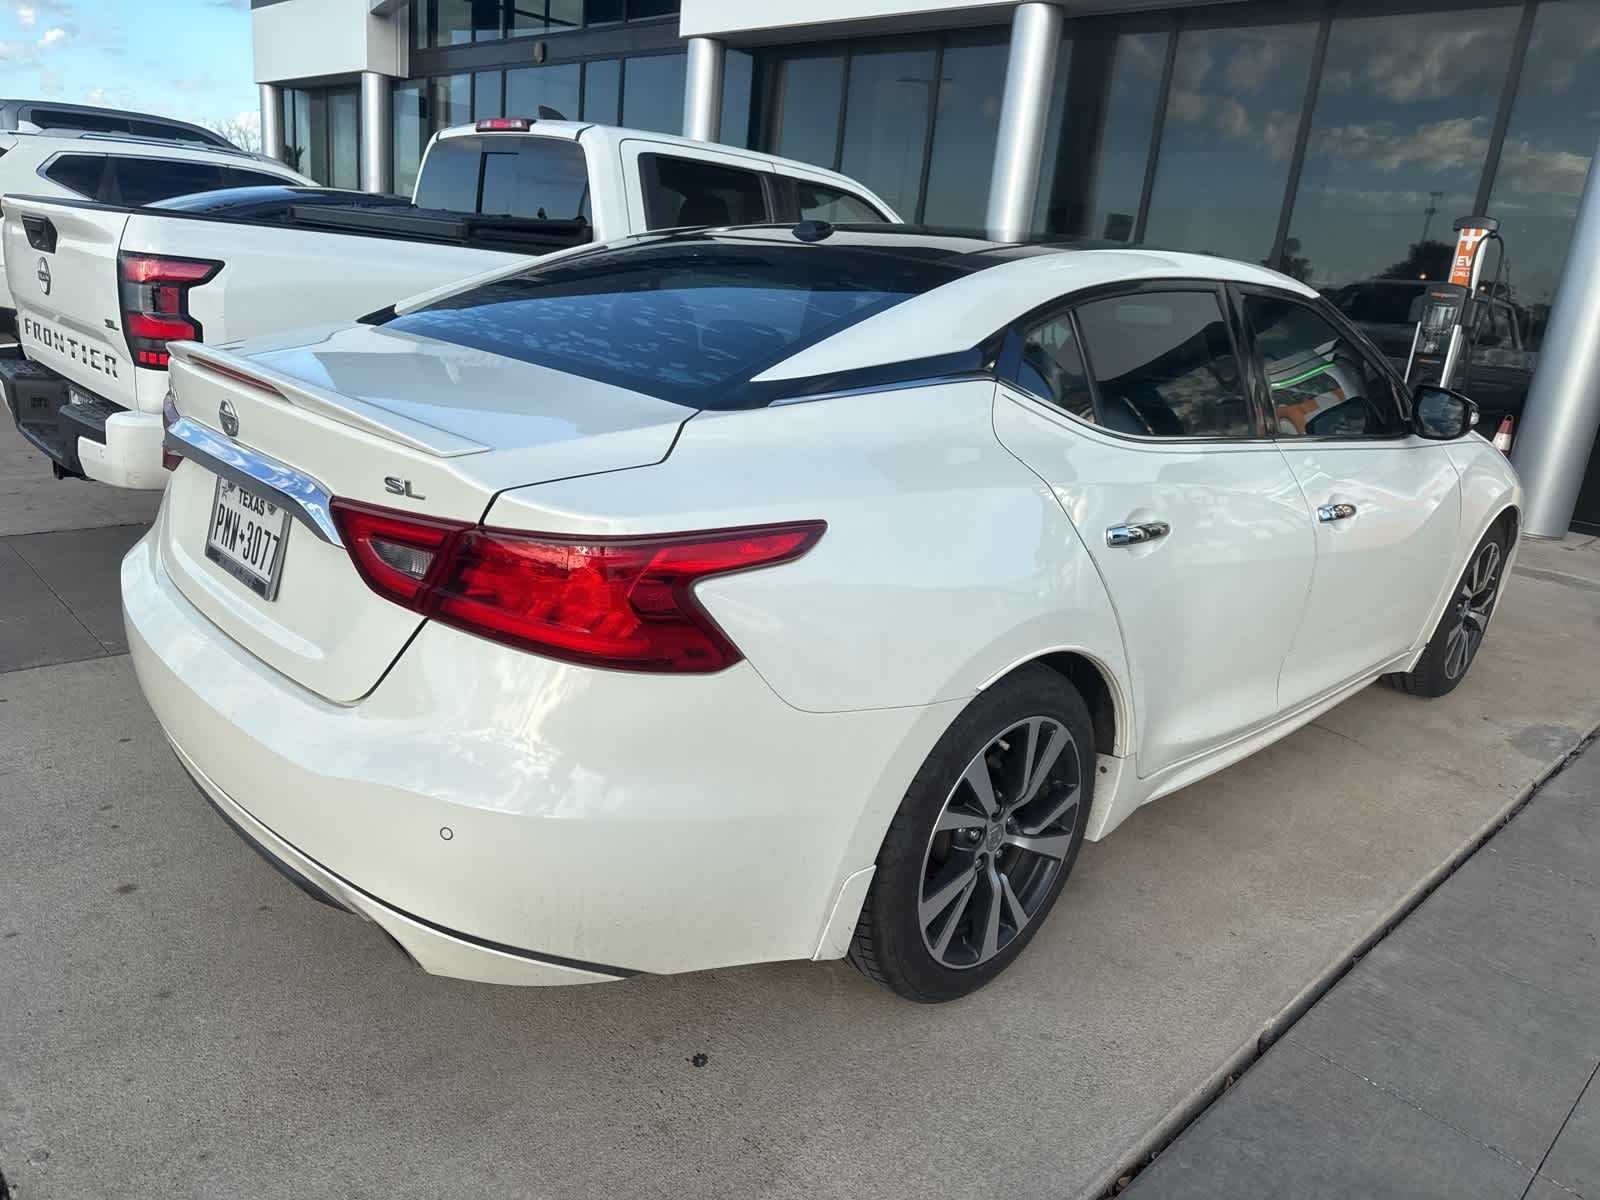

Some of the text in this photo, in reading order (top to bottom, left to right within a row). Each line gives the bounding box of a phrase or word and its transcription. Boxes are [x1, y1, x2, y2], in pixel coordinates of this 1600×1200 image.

[24, 318, 118, 378] FRONTIER
[238, 487, 265, 516] TEXAS
[384, 476, 426, 500] SL
